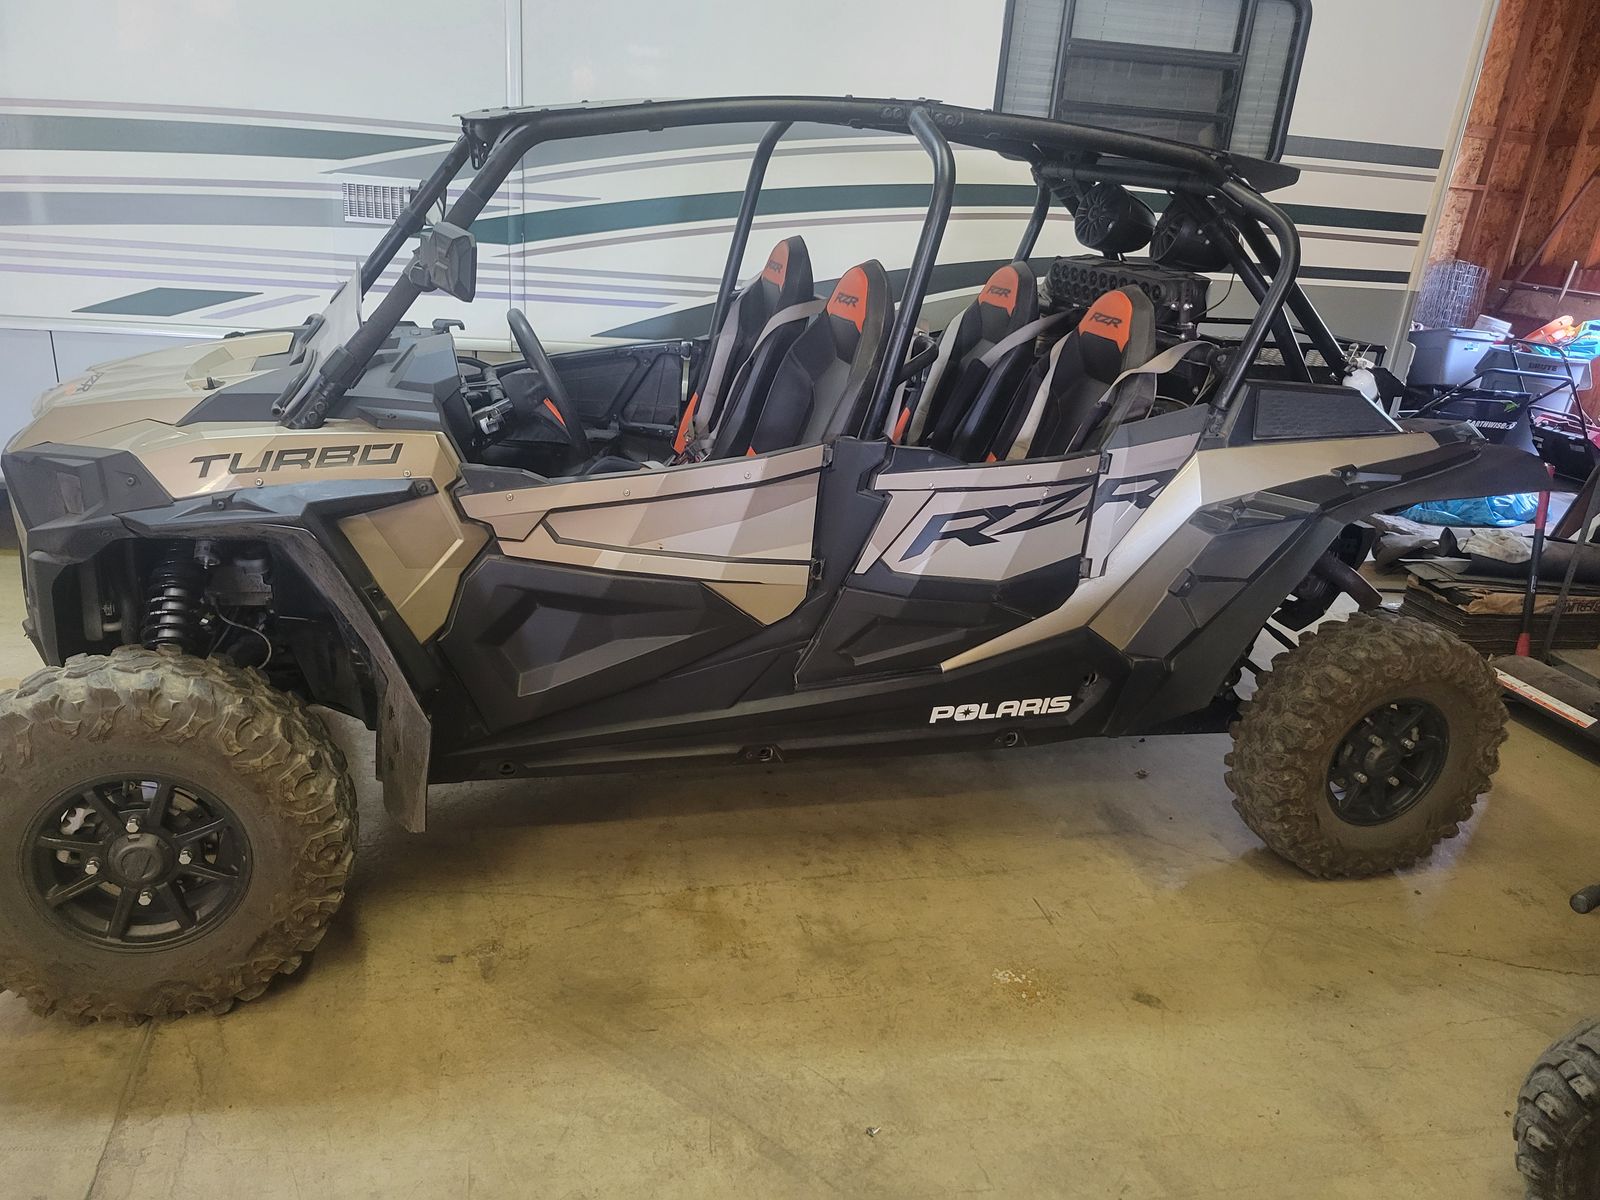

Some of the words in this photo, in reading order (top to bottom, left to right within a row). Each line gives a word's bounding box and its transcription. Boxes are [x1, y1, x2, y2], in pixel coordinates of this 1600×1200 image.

[835, 293, 859, 308] RZR
[986, 285, 1012, 298] RZR
[1088, 312, 1122, 329] RZR
[189, 442, 404, 478] TURBO
[898, 468, 1177, 562] RZR
[929, 695, 1072, 724] POLARIS
